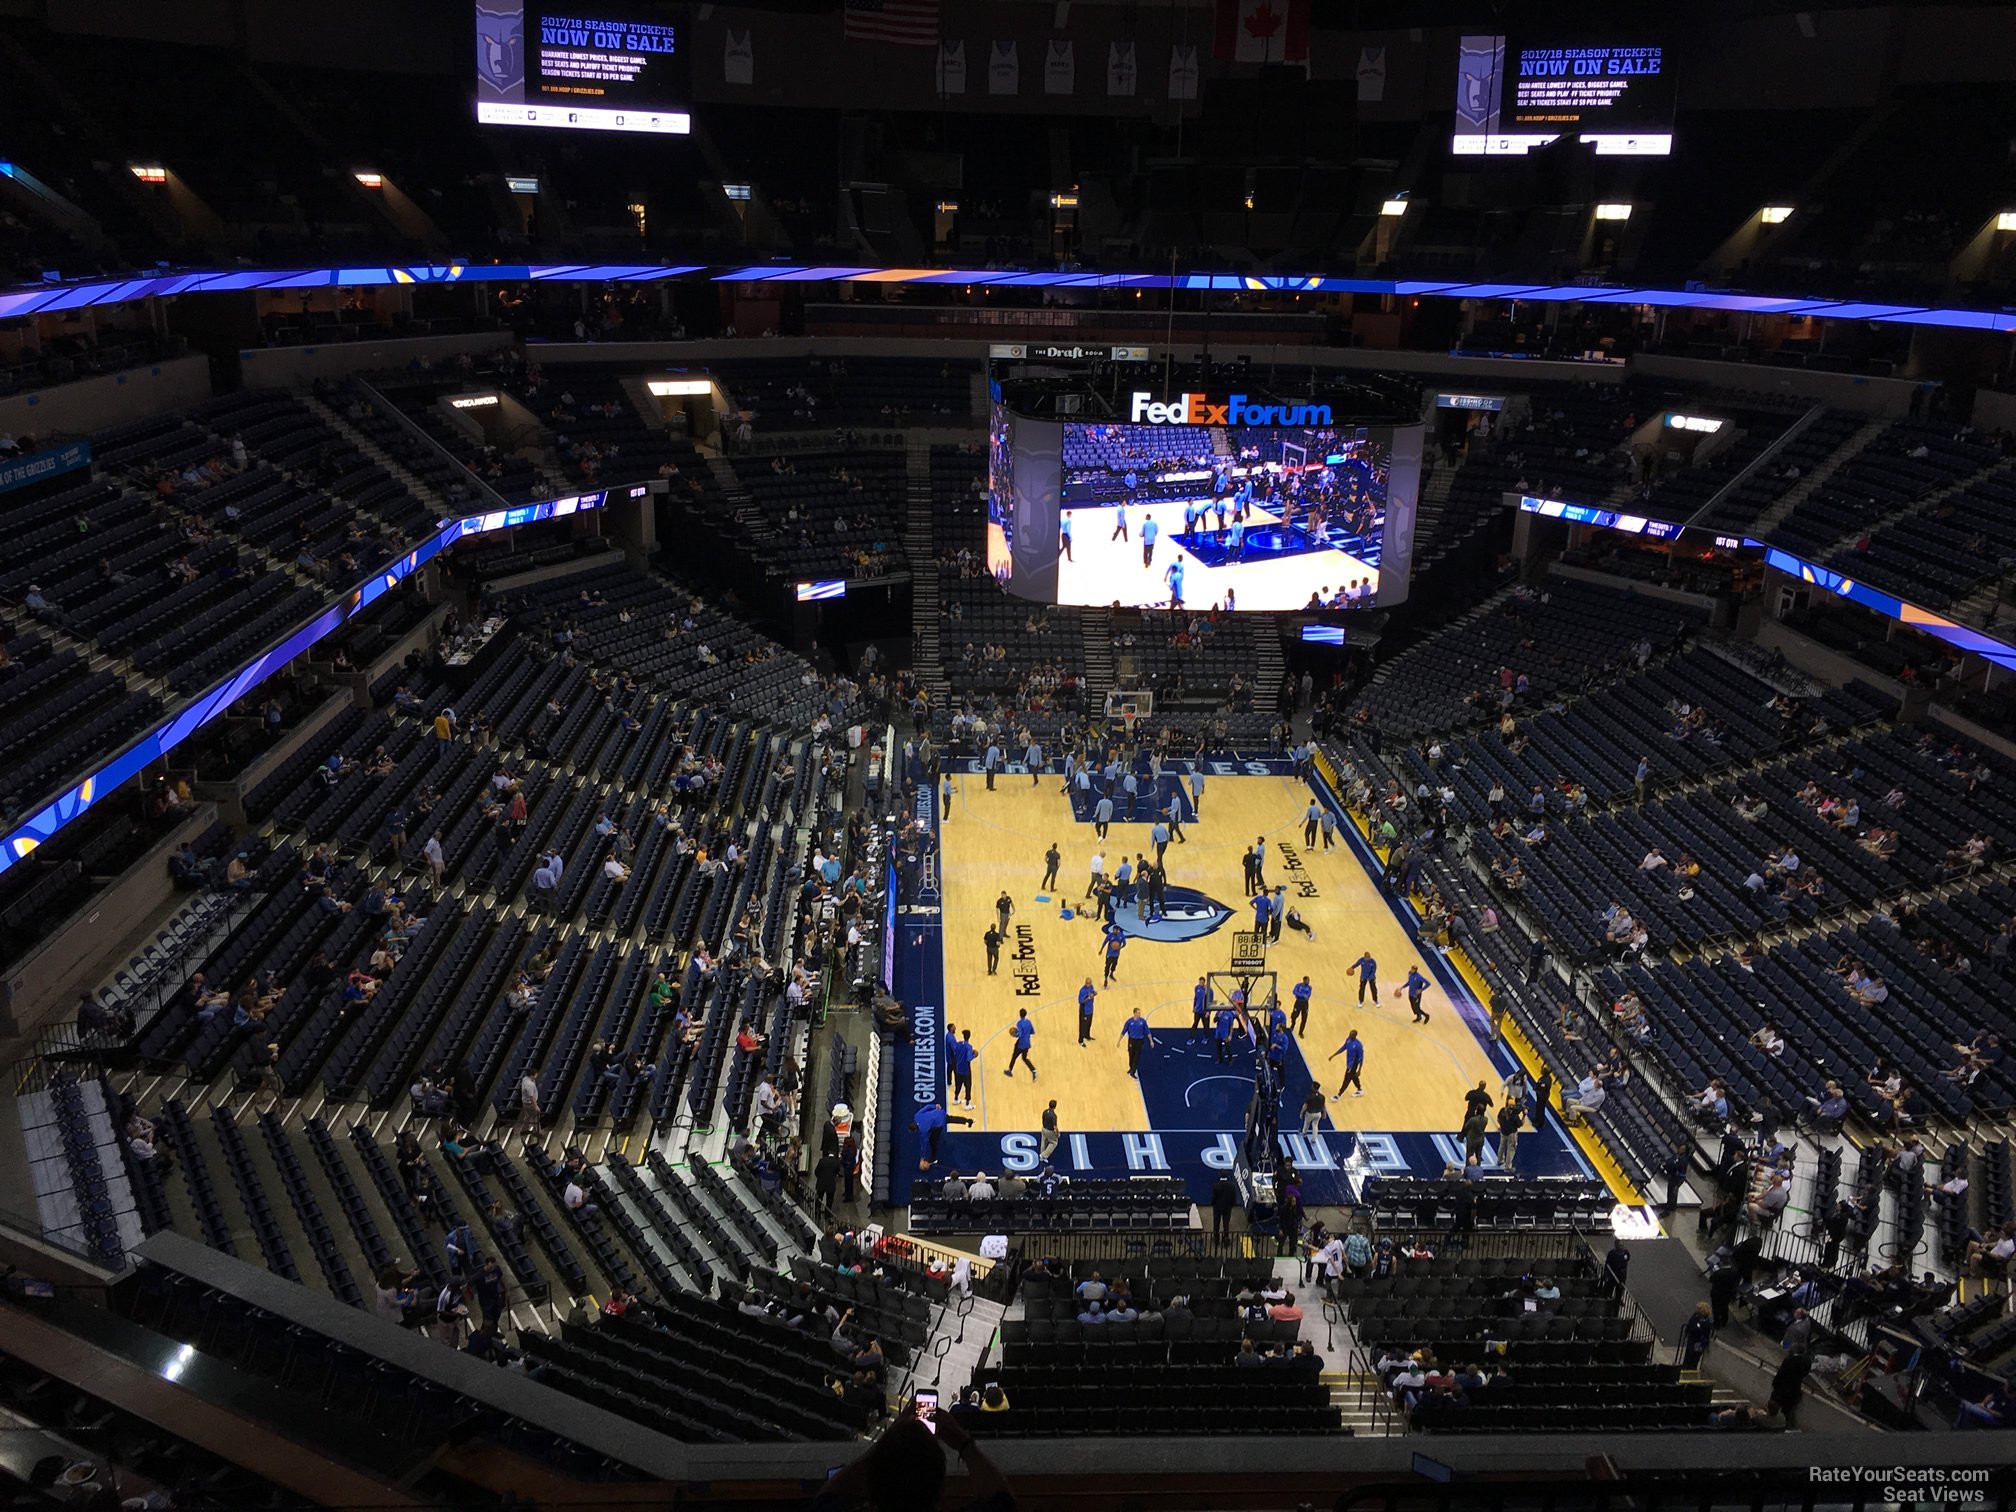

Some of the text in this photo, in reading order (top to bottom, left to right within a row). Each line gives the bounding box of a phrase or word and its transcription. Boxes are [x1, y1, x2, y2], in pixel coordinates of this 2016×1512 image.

[541, 17, 675, 36] 2017/18 SEASON TICKETS
[541, 28, 675, 53] NOW ON SALE
[541, 50, 569, 60] GUARANTEE
[570, 52, 589, 61] LOWEST
[609, 55, 629, 64] BIGGEST
[1521, 47, 1662, 60] 2017/18 SEASON TICKETS
[541, 59, 554, 67] BEST
[554, 60, 569, 68] SEATS
[569, 61, 580, 69] AND
[580, 62, 601, 71] PLAYOFF
[601, 63, 618, 71] TICKET
[1520, 58, 1661, 76] NOW ON SALE
[541, 69, 561, 77] SEASON
[561, 70, 581, 78] TICKETS
[581, 71, 596, 79] START
[1586, 98, 1597, 106] PER
[1047, 346, 1084, 360] Draft
[1131, 391, 1332, 426] FedExForum
[3, 470, 13, 485] OF
[12, 466, 26, 481] THE
[25, 456, 56, 477] GRIZZLIES
[1726, 538, 1739, 549] QTR
[1277, 843, 1320, 898] FedExForum
[1012, 925, 1041, 996] FedExForum
[914, 1006, 936, 1103] GRIZZLIES.COM
[1046, 1183, 1053, 1195] 5
